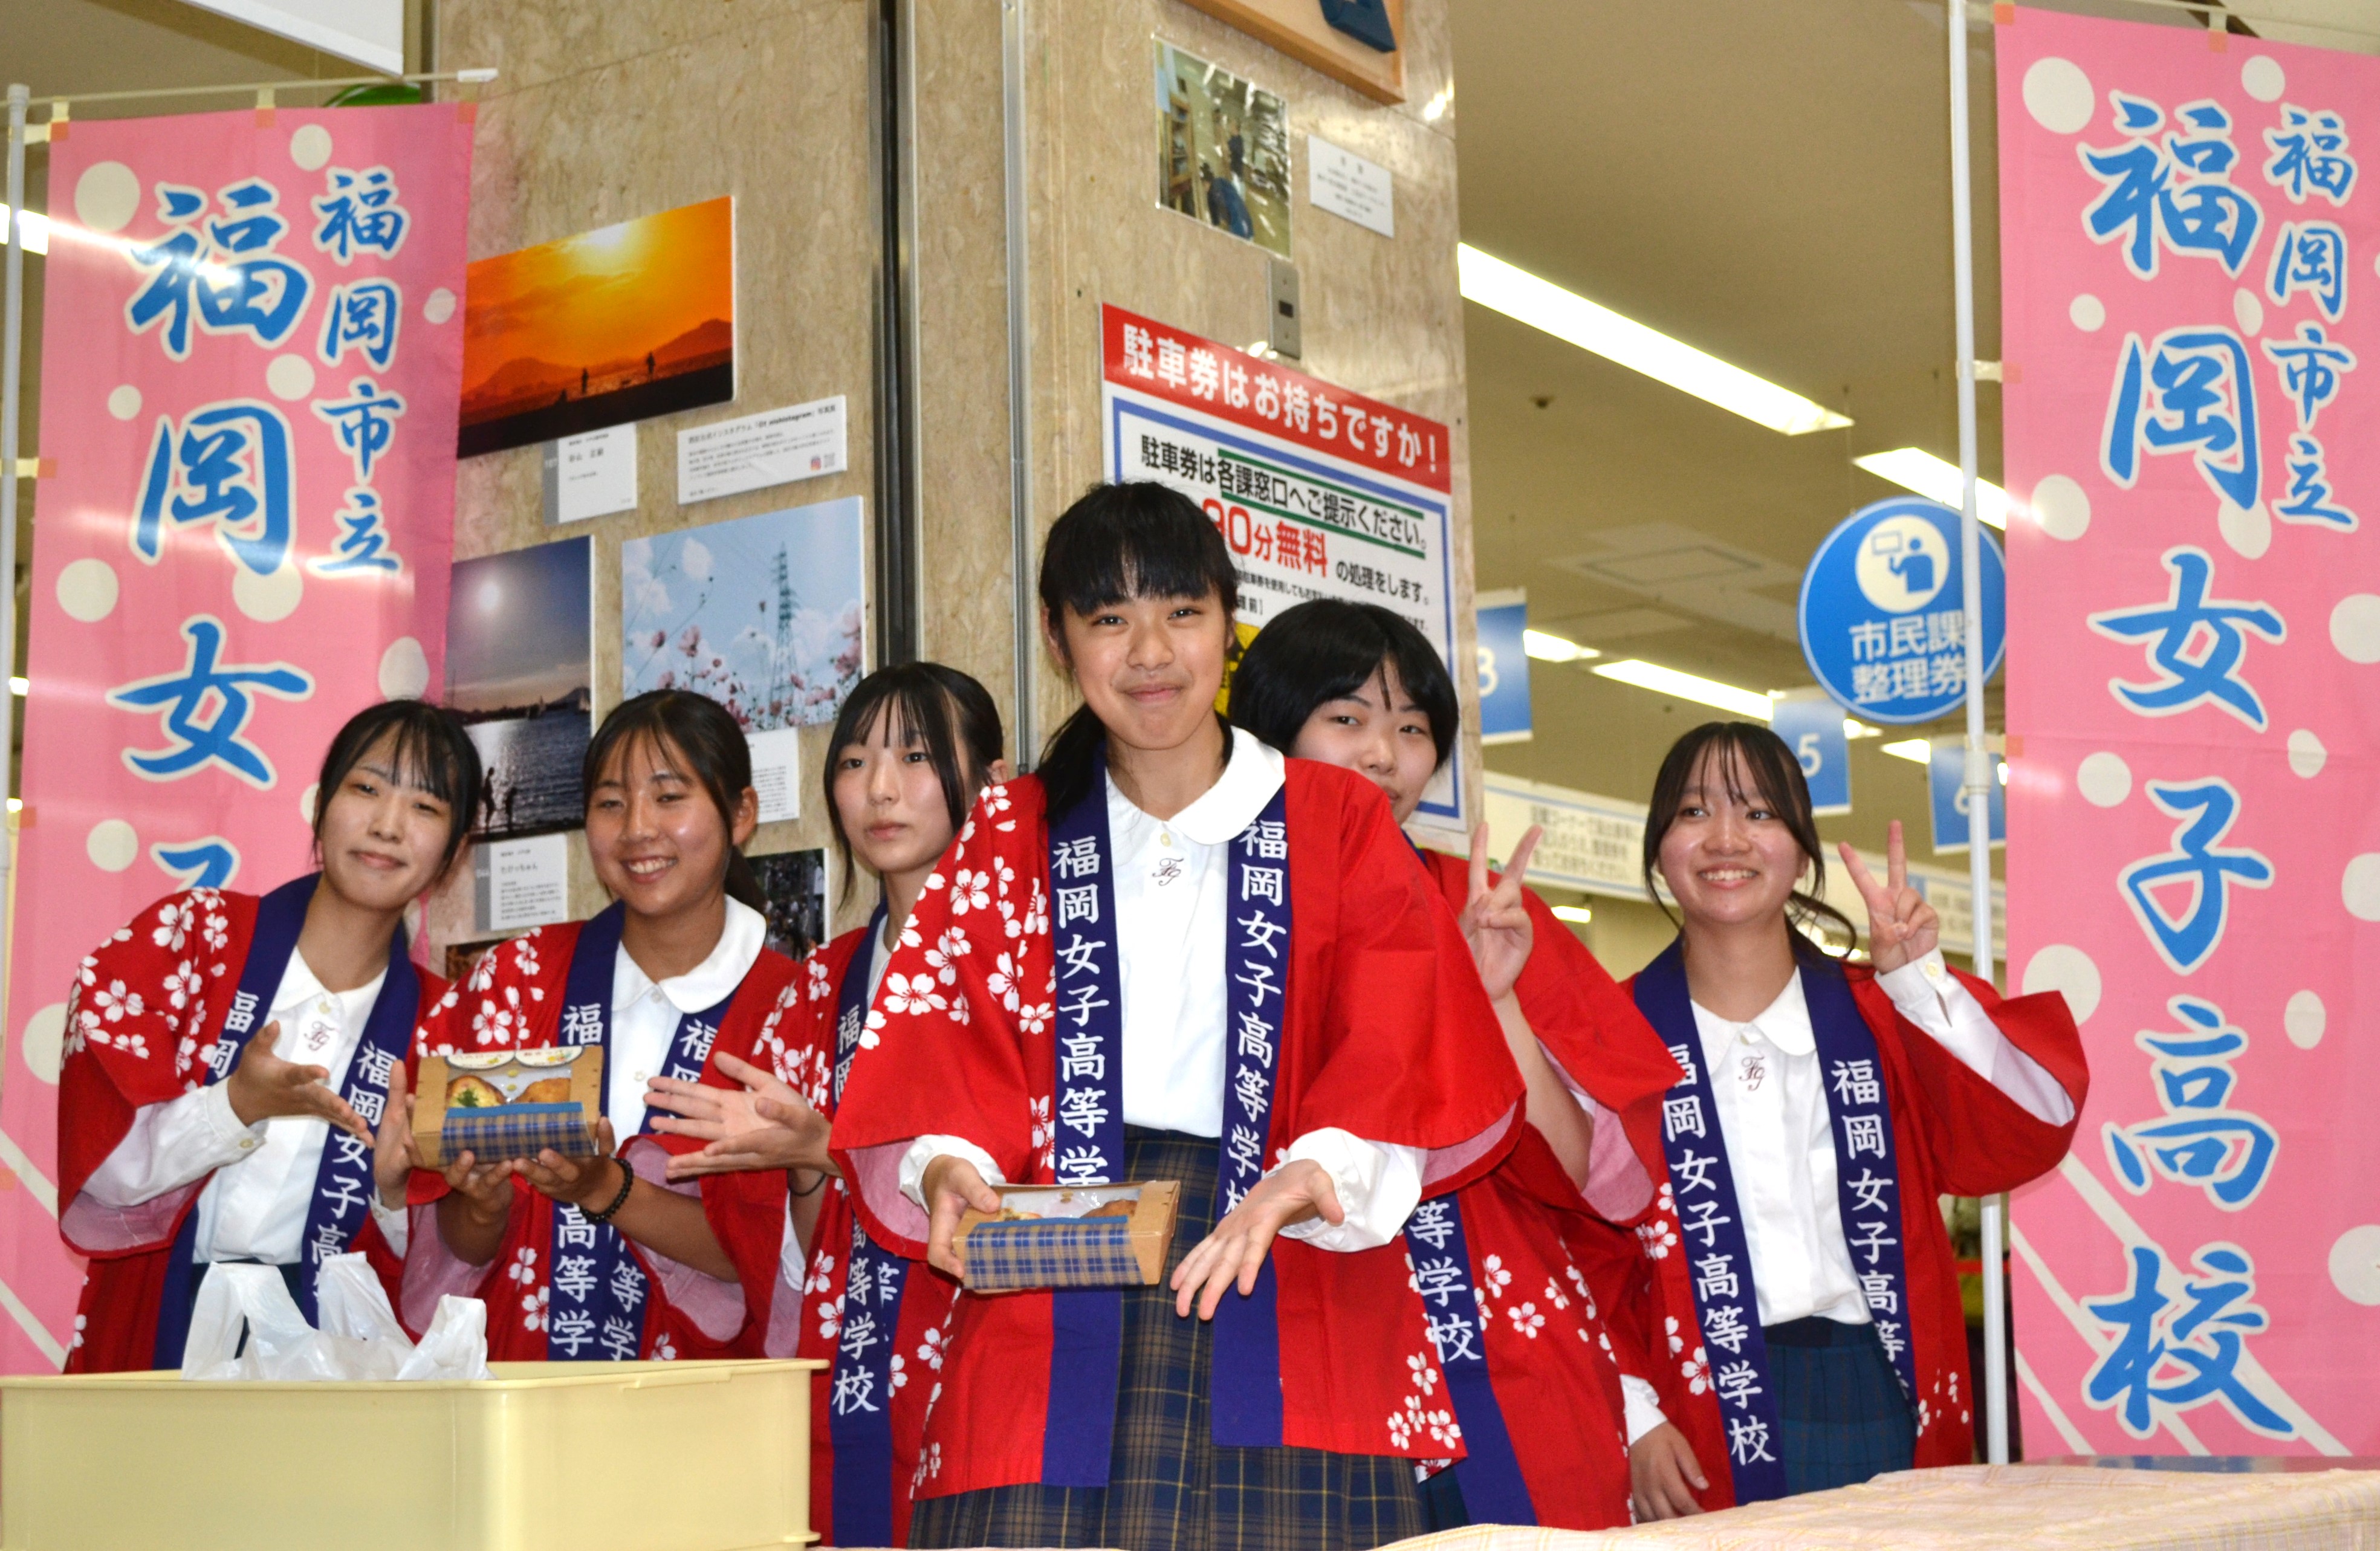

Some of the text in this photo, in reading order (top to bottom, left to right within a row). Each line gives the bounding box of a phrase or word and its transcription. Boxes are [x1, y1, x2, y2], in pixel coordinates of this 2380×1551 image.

[317, 173, 402, 571] 福岡市立
[2265, 111, 2353, 525] 福岡市立
[1797, 732, 1822, 779] 5
[1848, 609, 1964, 661] 市民課
[1852, 653, 1965, 704] 整理券
[2086, 99, 2295, 1432] 福岡女子高校
[1830, 1058, 1908, 1399] 福岡女子高等
